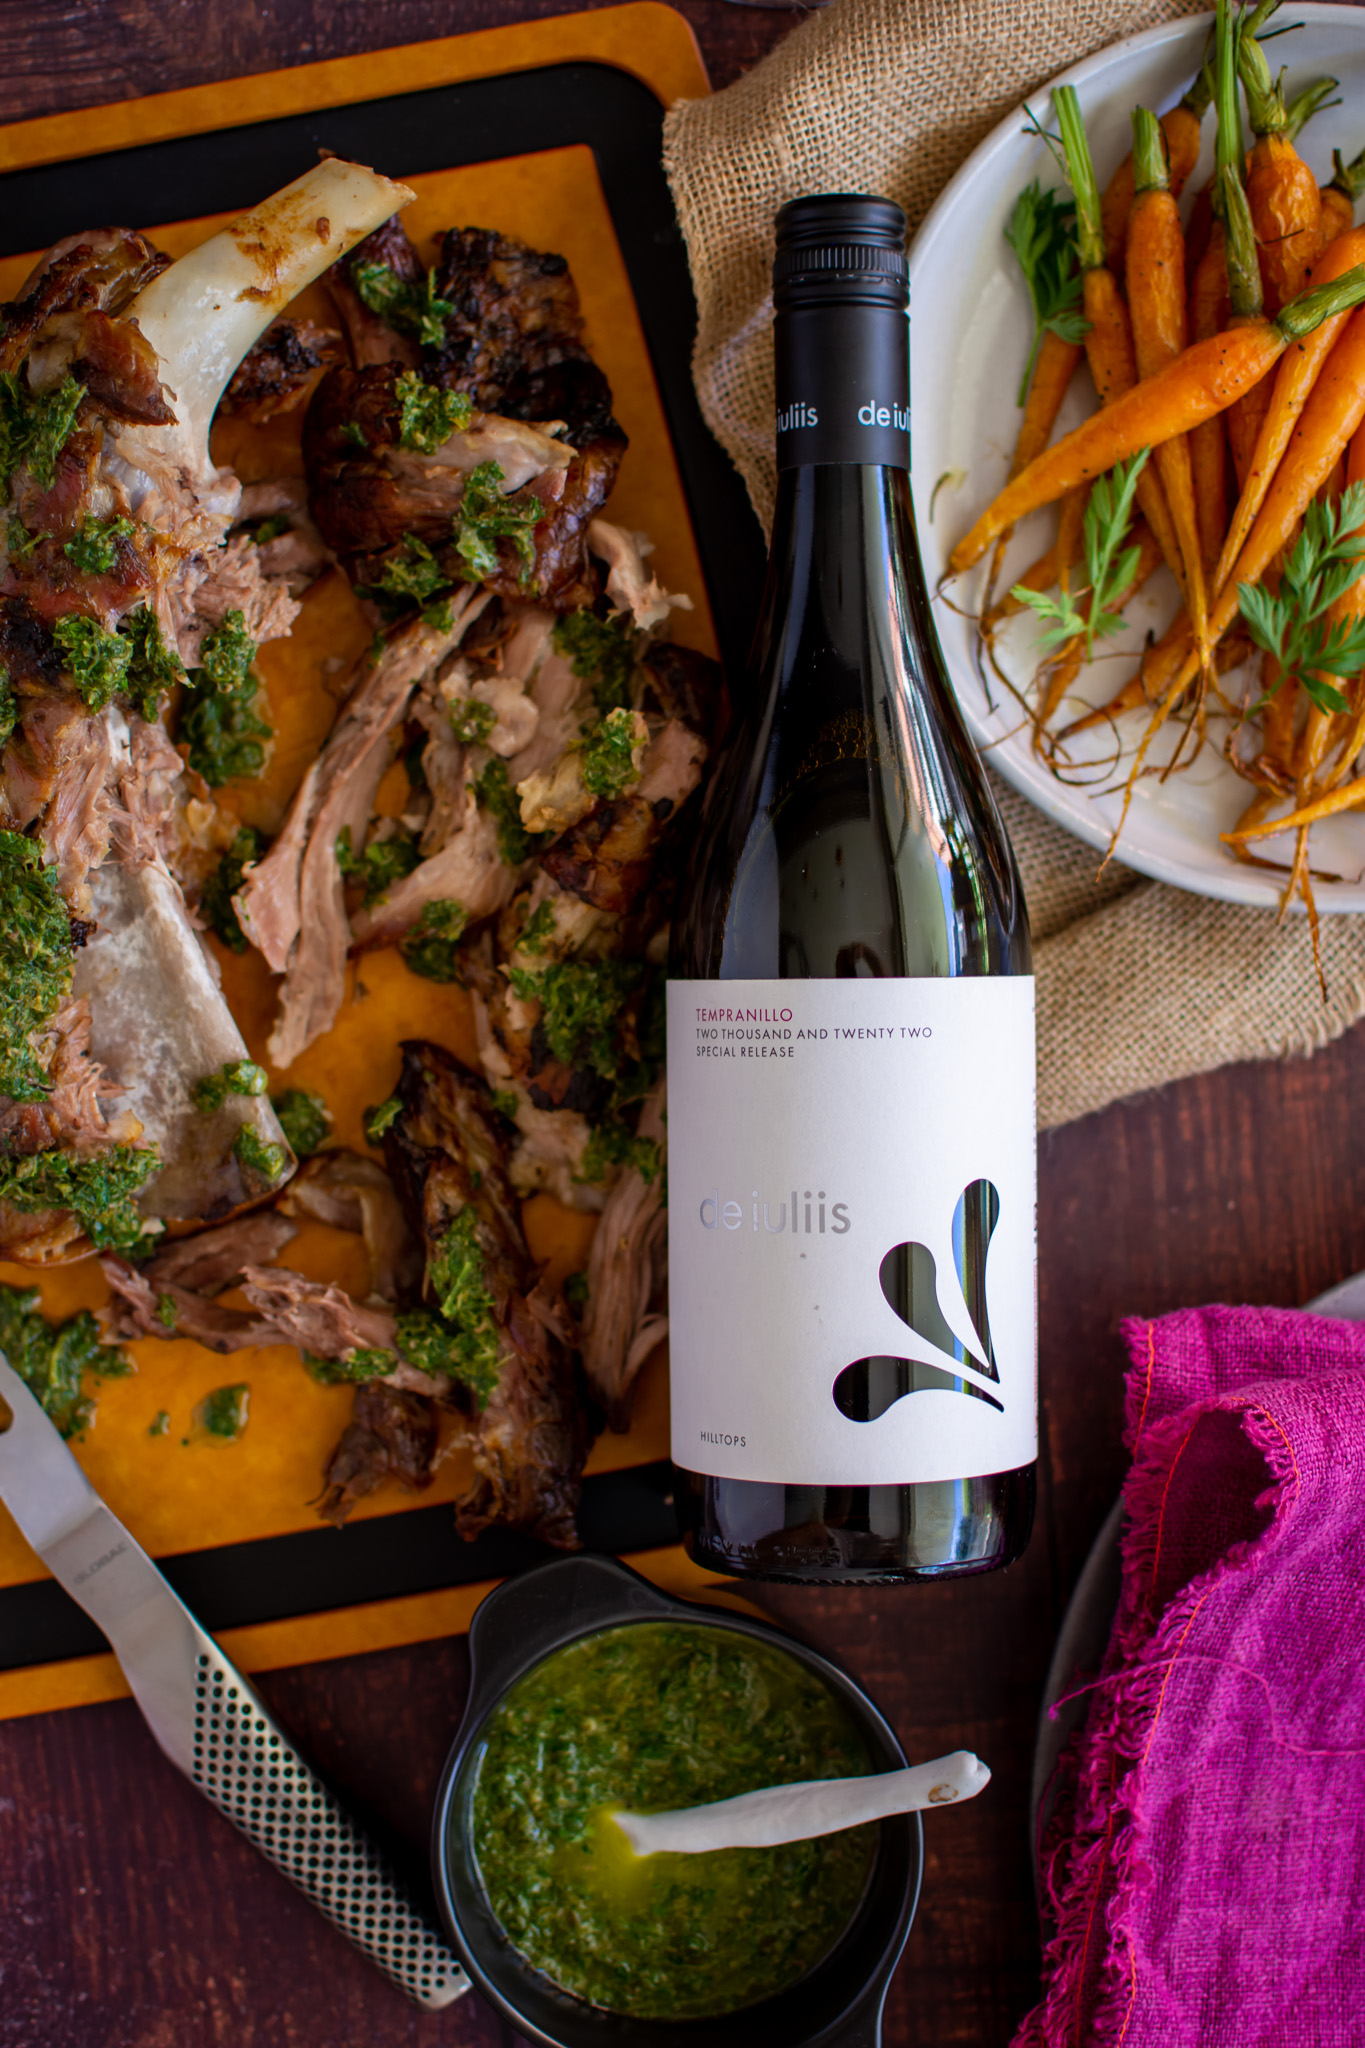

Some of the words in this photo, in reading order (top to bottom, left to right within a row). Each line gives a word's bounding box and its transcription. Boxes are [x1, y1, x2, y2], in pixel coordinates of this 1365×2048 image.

[777, 402, 819, 432] iuliis
[857, 400, 891, 428] de
[696, 1008, 793, 1023] TEMPRANILLO
[696, 1028, 719, 1040] TWO
[721, 1028, 792, 1040] THOUSAND
[796, 1028, 829, 1040] AND
[834, 1027, 895, 1040] TWENTY
[900, 1027, 933, 1039] TWO
[696, 1045, 736, 1058] SPECIAL
[740, 1046, 795, 1058] RELEASE
[699, 1187, 743, 1231] de
[752, 1190, 852, 1235] iuliis
[700, 1430, 747, 1448] HILLTOPS
